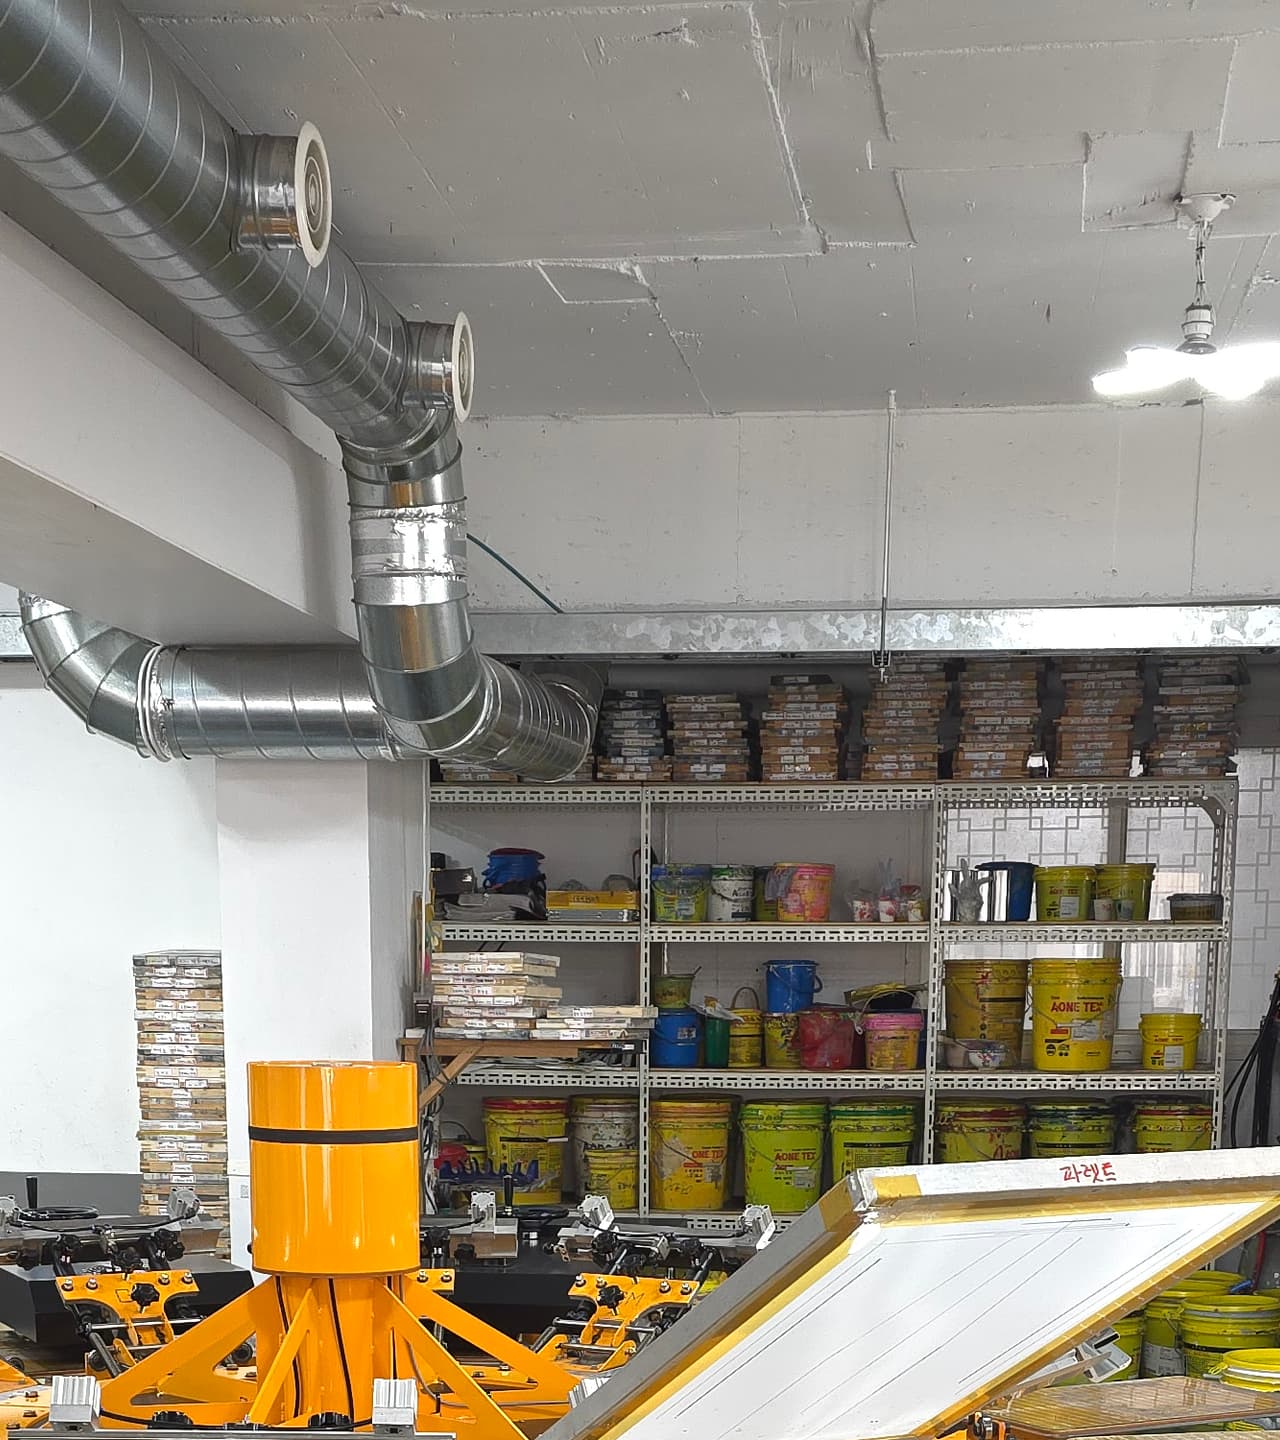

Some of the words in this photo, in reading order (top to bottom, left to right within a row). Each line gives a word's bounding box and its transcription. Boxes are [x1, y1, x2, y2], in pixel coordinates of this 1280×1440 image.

[1051, 1001, 1080, 1013] AONE
[1083, 1001, 1103, 1012] TEX
[774, 1152, 800, 1161] AONE
[1059, 1162, 1117, 1183] 파렛트
